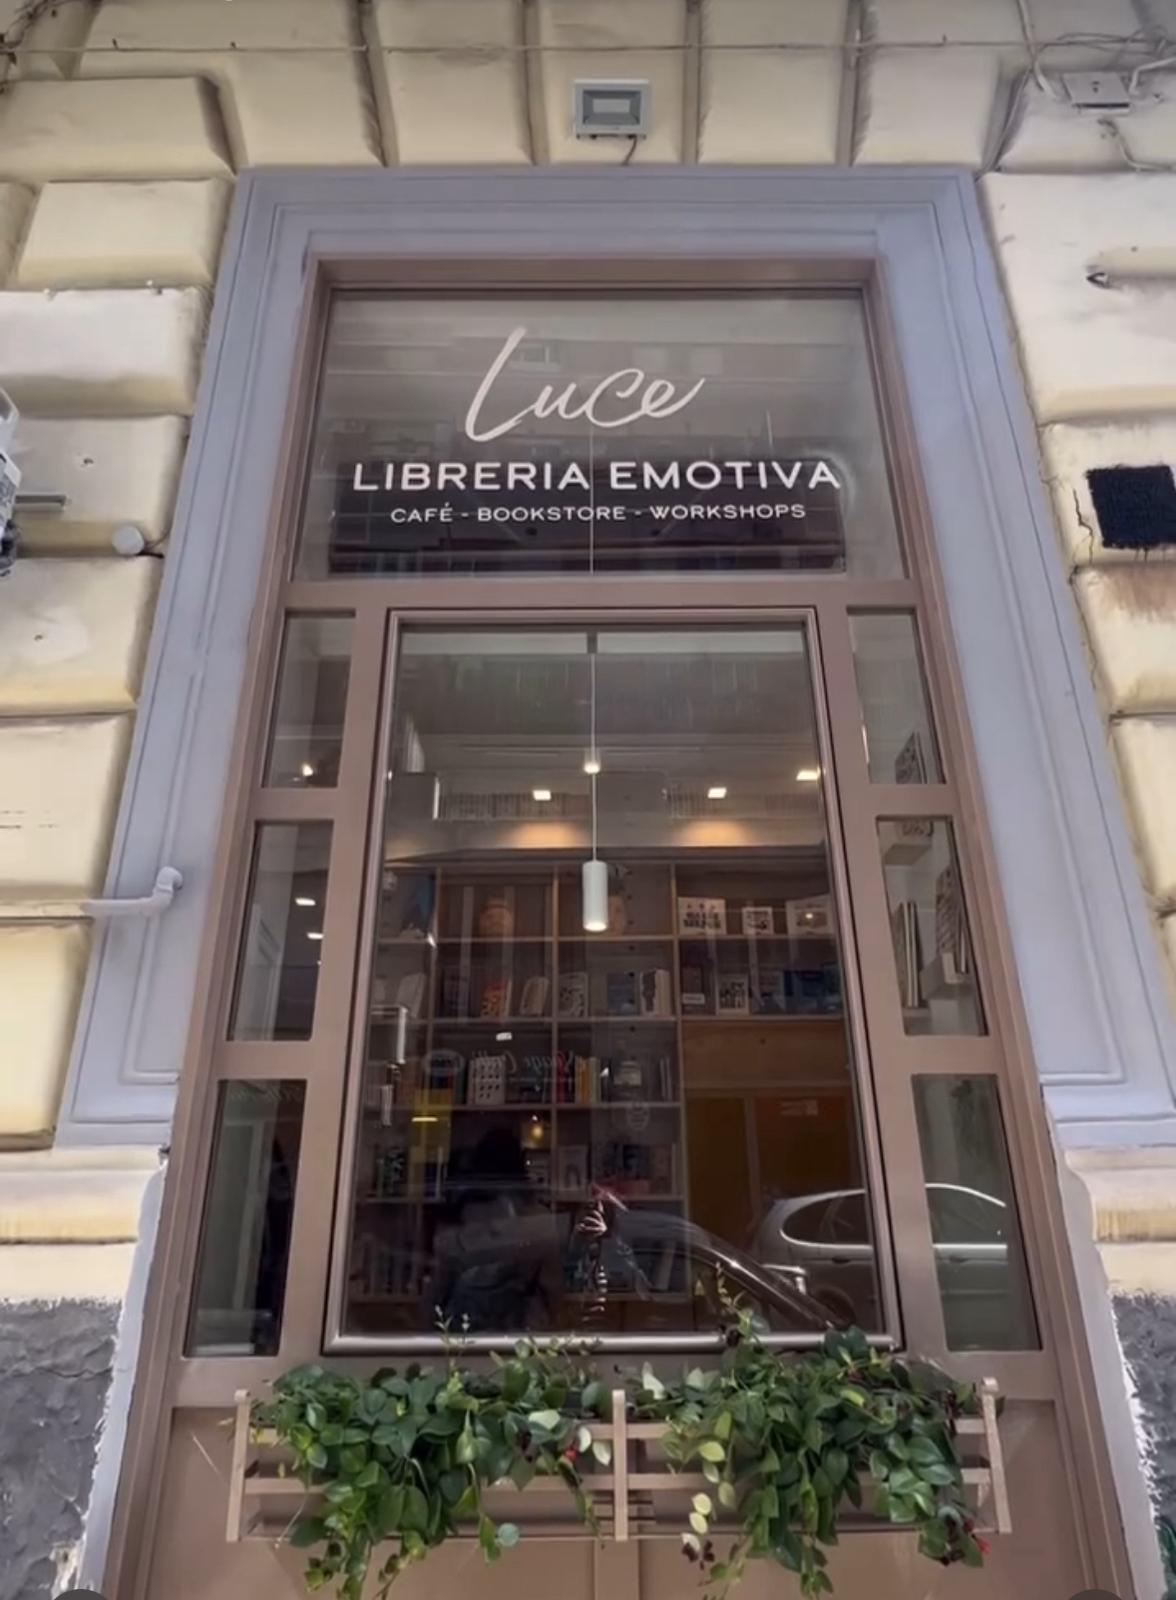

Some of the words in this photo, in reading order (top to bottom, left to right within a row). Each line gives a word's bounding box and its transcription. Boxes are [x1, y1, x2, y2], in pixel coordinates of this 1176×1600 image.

[465, 327, 705, 442] Luce
[353, 462, 591, 491] LIBRERIA
[609, 461, 842, 490] EMOTIVA
[390, 502, 453, 523] CAFÉ
[477, 506, 626, 522] BOOKSTORE
[649, 503, 806, 520] WORKSHOPS
